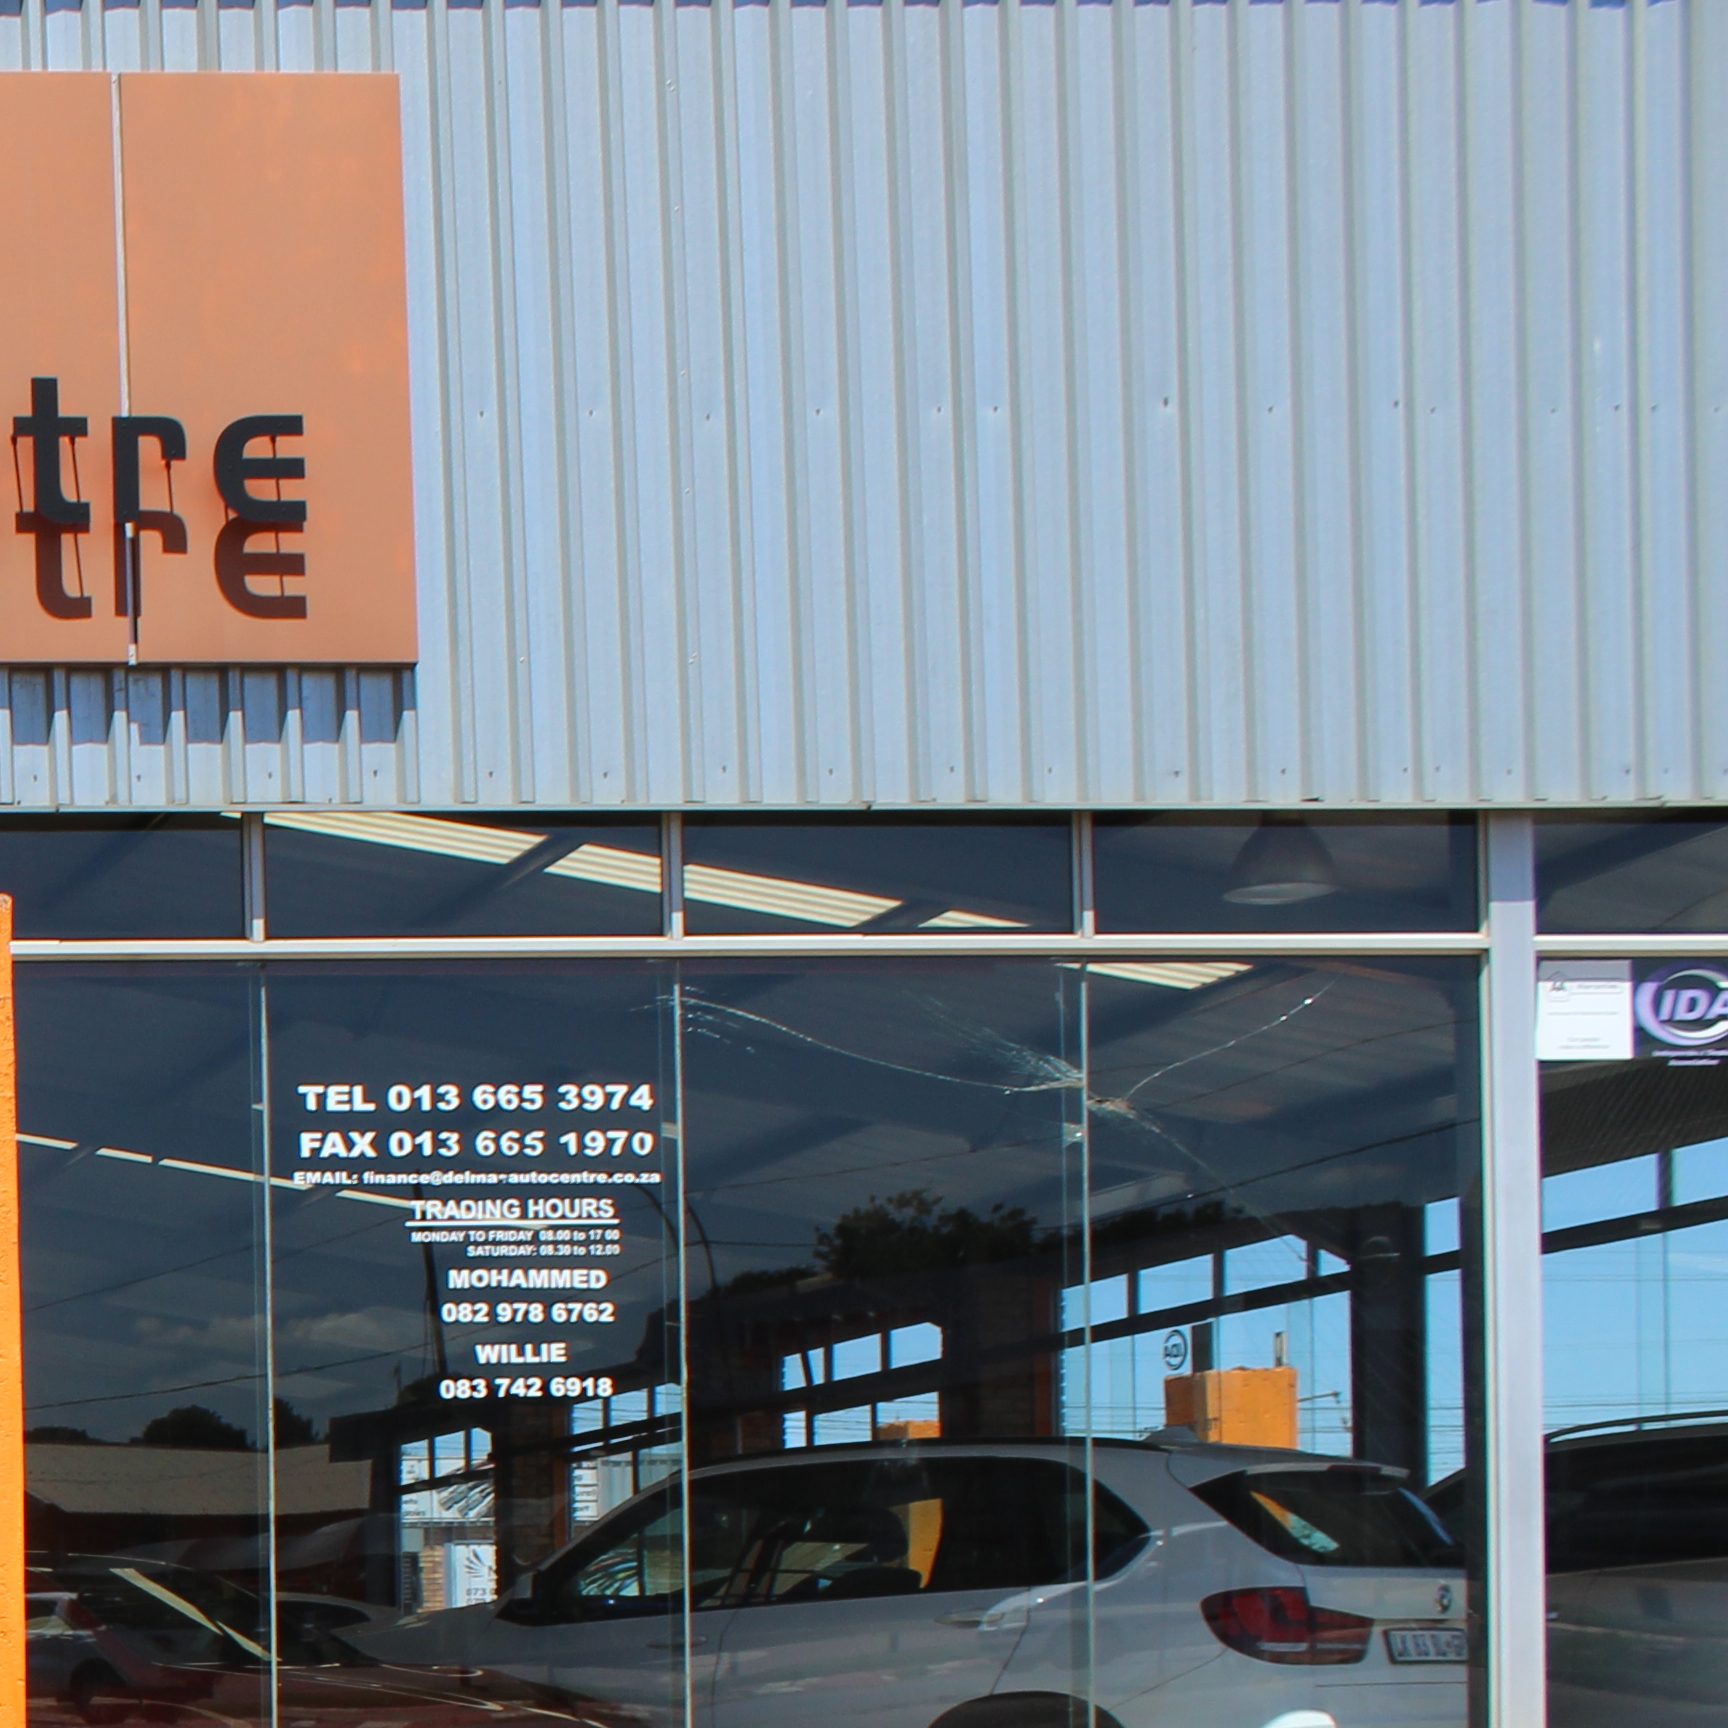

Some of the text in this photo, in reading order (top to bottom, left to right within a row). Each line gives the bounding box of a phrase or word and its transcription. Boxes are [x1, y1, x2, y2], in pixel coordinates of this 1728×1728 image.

[298, 1085, 653, 1111] TEL 013 665 3974
[300, 1131, 653, 1157] FAX 013 665 1970
[294, 1171, 359, 1184] EMAIL:
[411, 1198, 614, 1219] TRADING HOURS
[411, 1231, 466, 1242] MONDAY
[468, 1231, 486, 1242] TO
[488, 1230, 534, 1242] FRIDAY
[573, 1229, 586, 1240] to
[467, 1245, 537, 1257] SATURDAY:
[573, 1245, 586, 1256] to
[448, 1269, 608, 1289] MOHAMMED
[442, 1302, 615, 1323] 082 978 6762
[475, 1342, 567, 1364] WILLIE
[440, 1376, 614, 1399] 083 742 6918
